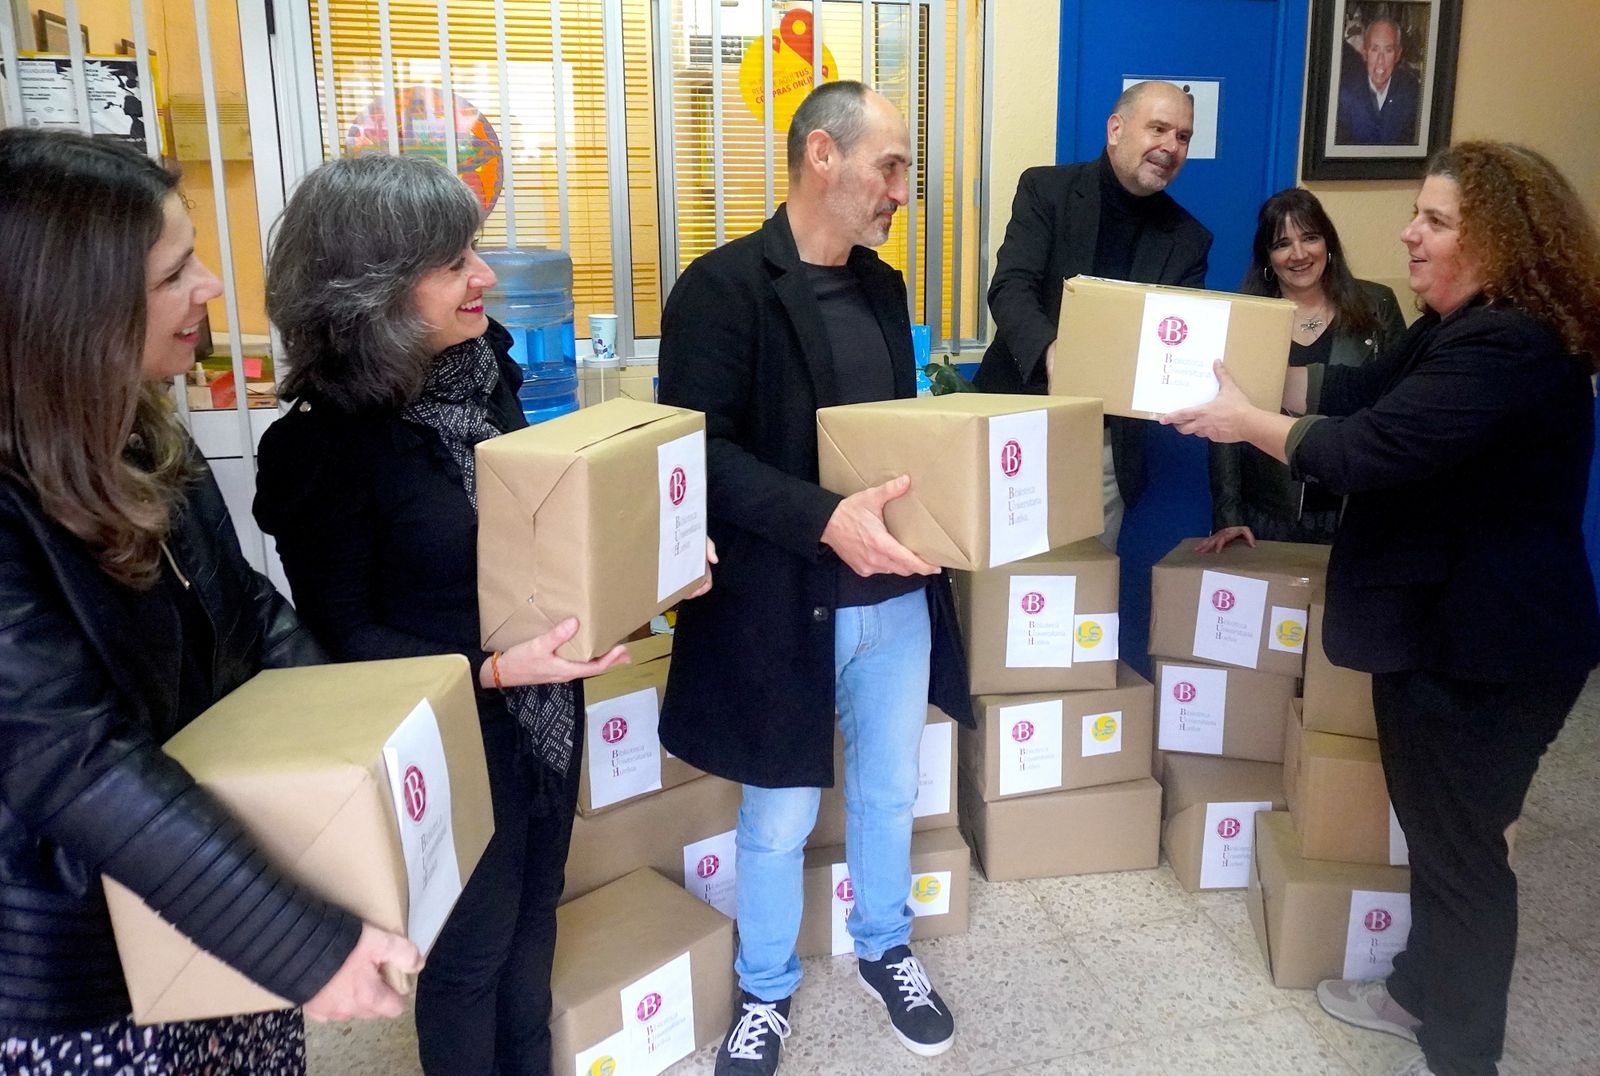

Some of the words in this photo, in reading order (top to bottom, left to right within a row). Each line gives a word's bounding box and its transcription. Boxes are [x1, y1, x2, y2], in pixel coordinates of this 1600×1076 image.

[795, 68, 809, 78] TUS
[755, 84, 791, 104] COPRAS
[792, 76, 814, 89] ONLIN
[1161, 318, 1182, 342] B
[1005, 444, 1018, 473] B
[672, 471, 683, 503] B
[1025, 593, 1040, 612] B
[1217, 590, 1230, 610] B
[1178, 683, 1192, 701] B
[608, 718, 622, 742] B
[1016, 722, 1029, 741] B
[406, 770, 424, 820] B
[1221, 819, 1236, 837] B
[700, 855, 716, 878] B
[1370, 910, 1387, 930] B
[640, 994, 658, 1019] B
